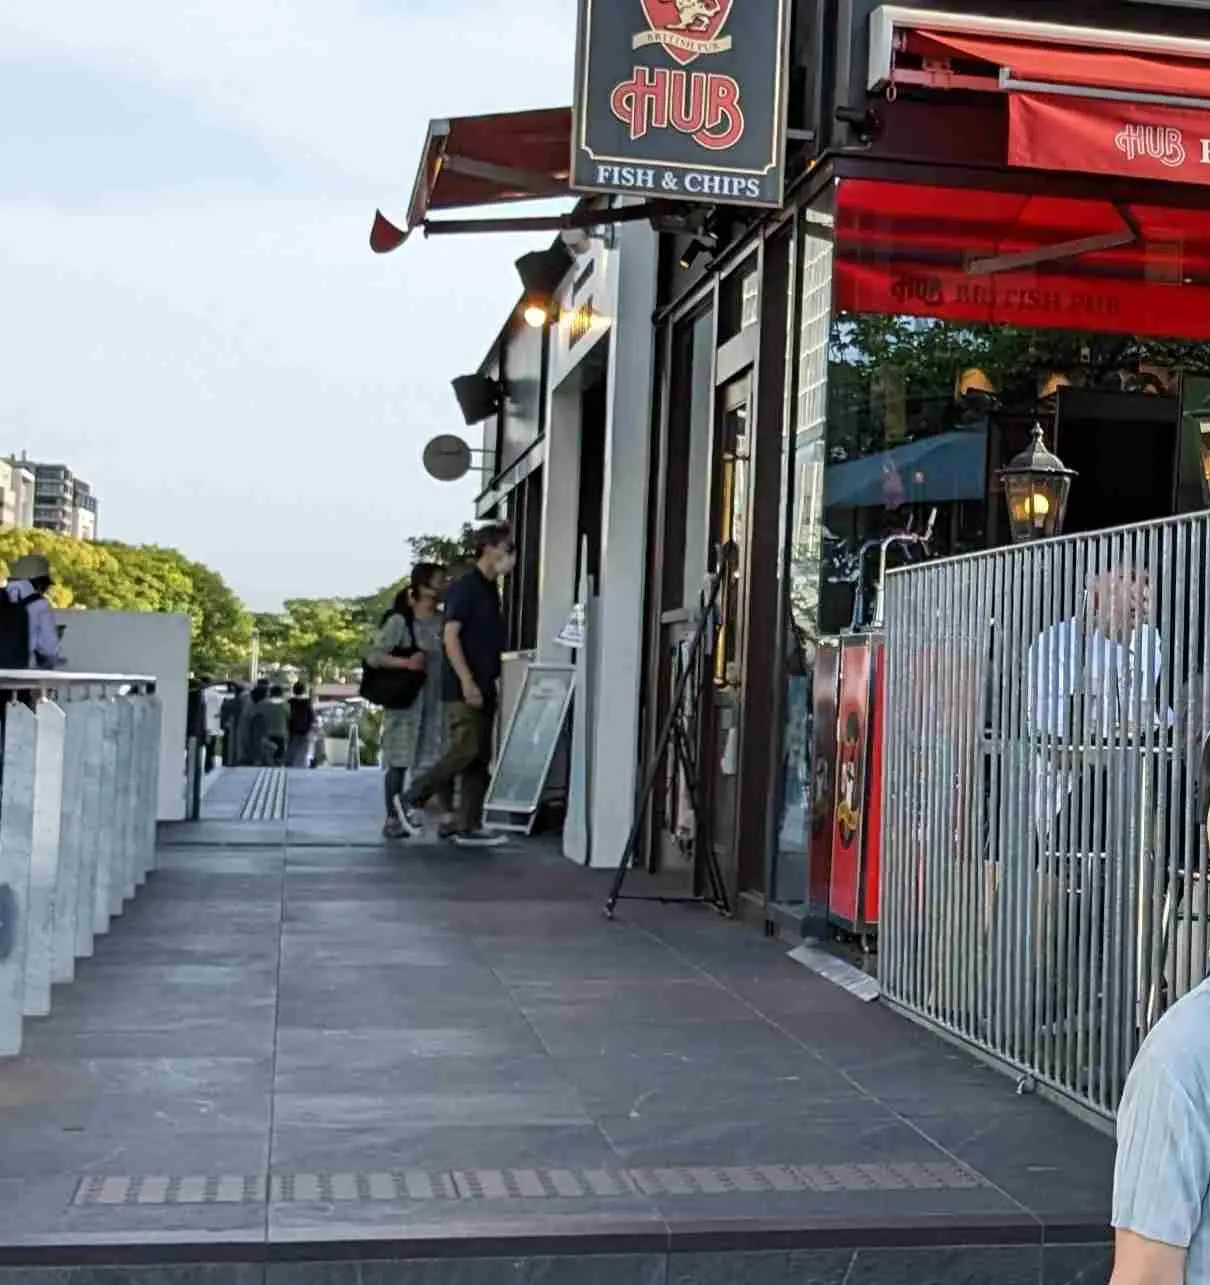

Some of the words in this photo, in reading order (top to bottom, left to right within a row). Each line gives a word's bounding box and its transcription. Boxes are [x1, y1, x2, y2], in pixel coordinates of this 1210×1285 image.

[611, 66, 744, 150] HUB
[1114, 123, 1186, 167] HUB
[595, 165, 654, 188] FISH
[661, 171, 679, 190] &
[684, 173, 760, 197] CHIPS
